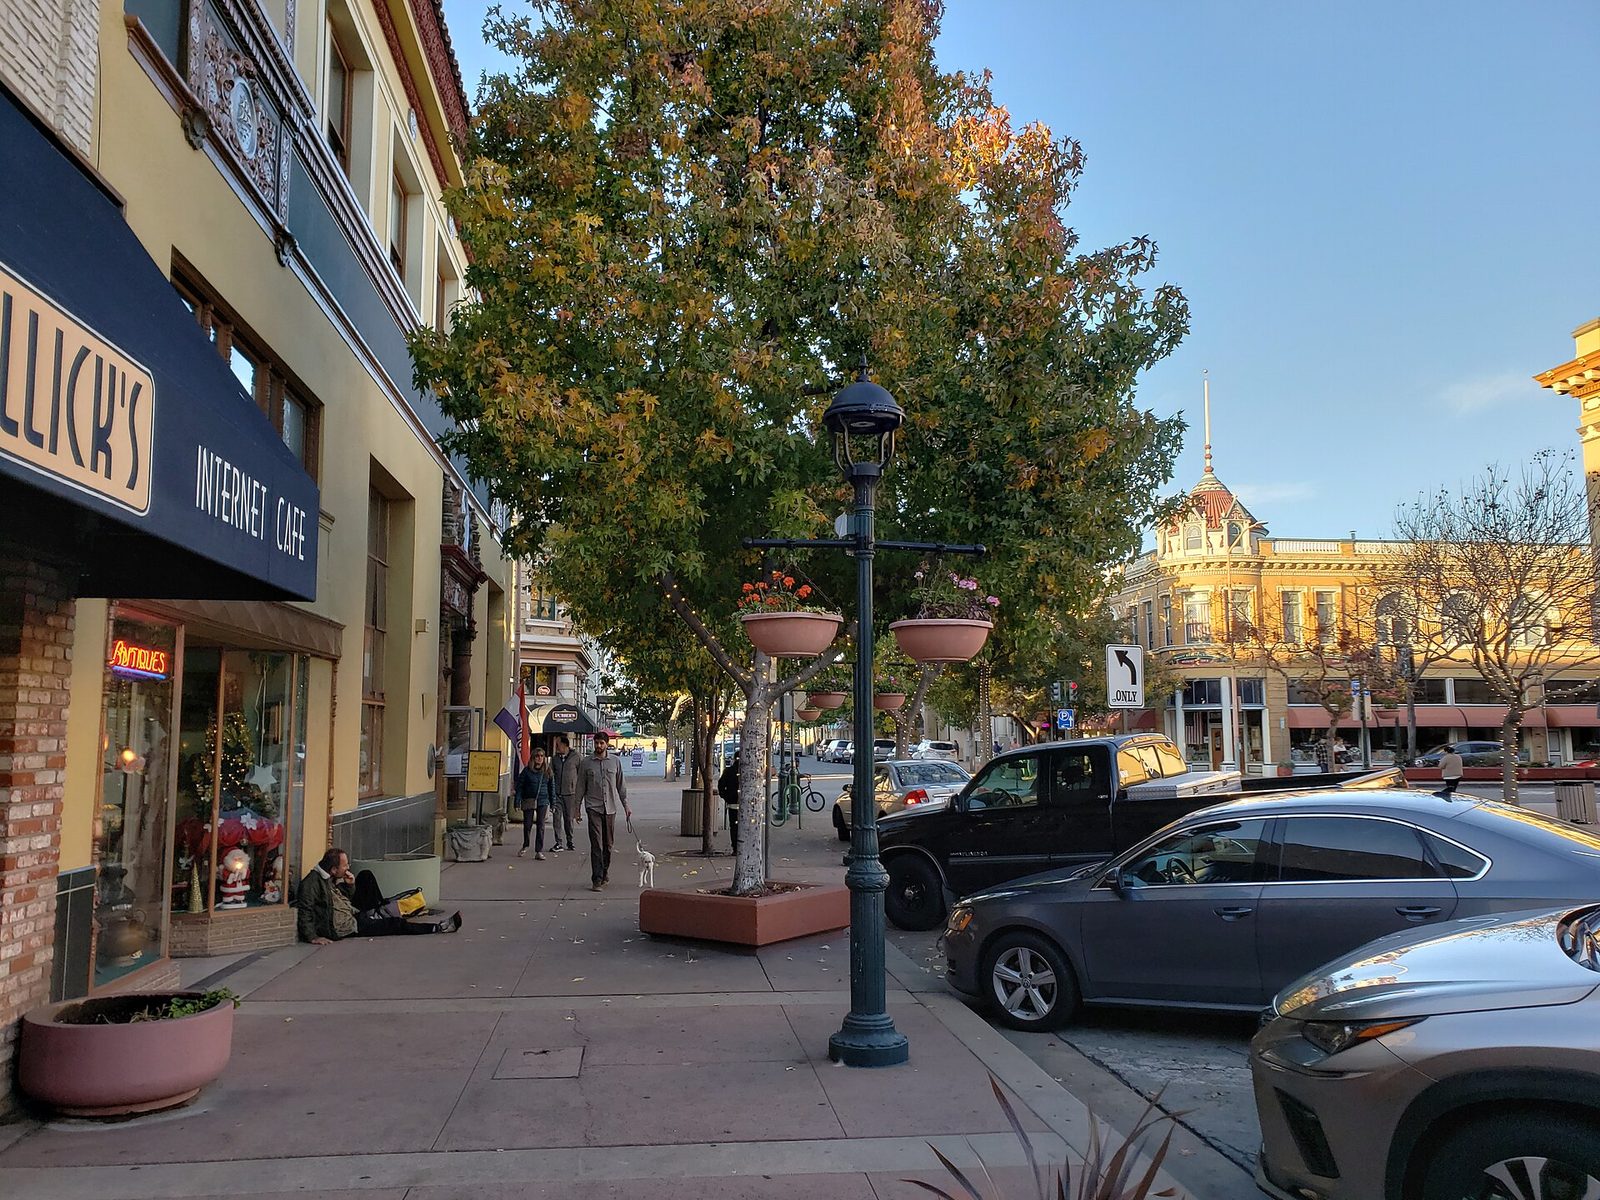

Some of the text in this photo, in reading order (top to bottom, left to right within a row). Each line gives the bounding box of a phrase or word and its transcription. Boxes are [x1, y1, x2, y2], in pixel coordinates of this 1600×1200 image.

[196, 445, 306, 561] INTERNET CAFE
[109, 640, 165, 673] ANTIQUES
[1115, 689, 1137, 703] ONLY
